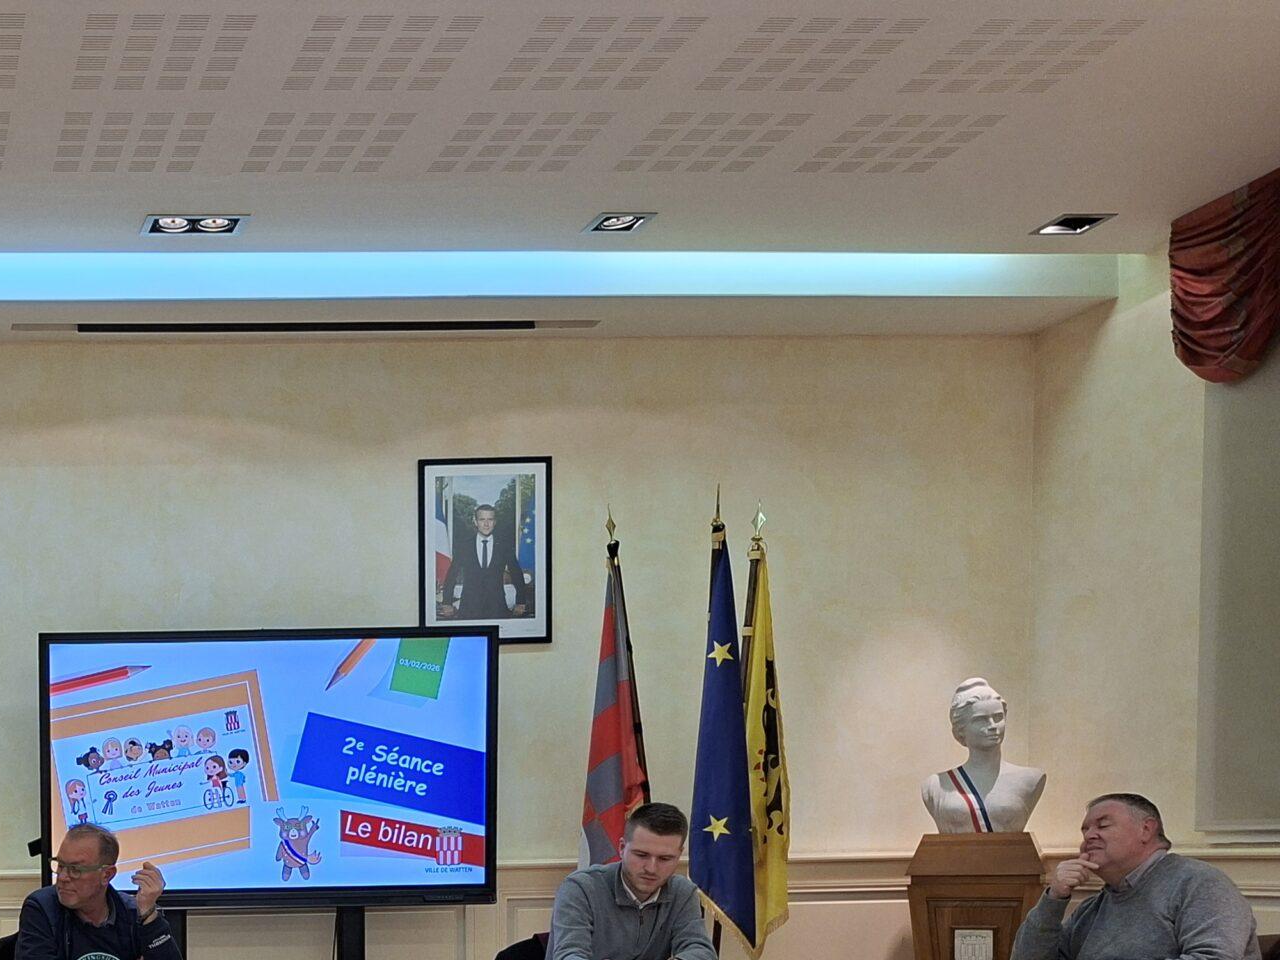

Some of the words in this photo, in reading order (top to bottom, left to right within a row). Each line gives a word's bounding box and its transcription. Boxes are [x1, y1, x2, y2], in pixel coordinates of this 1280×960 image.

[399, 657, 441, 673] 03/02/2026
[99, 768, 142, 786] Conseil
[143, 756, 203, 778] Municipal
[371, 744, 445, 776] Séance
[122, 787, 140, 799] des
[145, 780, 184, 798] Jeunes
[346, 763, 428, 796] plénière
[345, 814, 372, 838] Le
[378, 821, 432, 850] bilan
